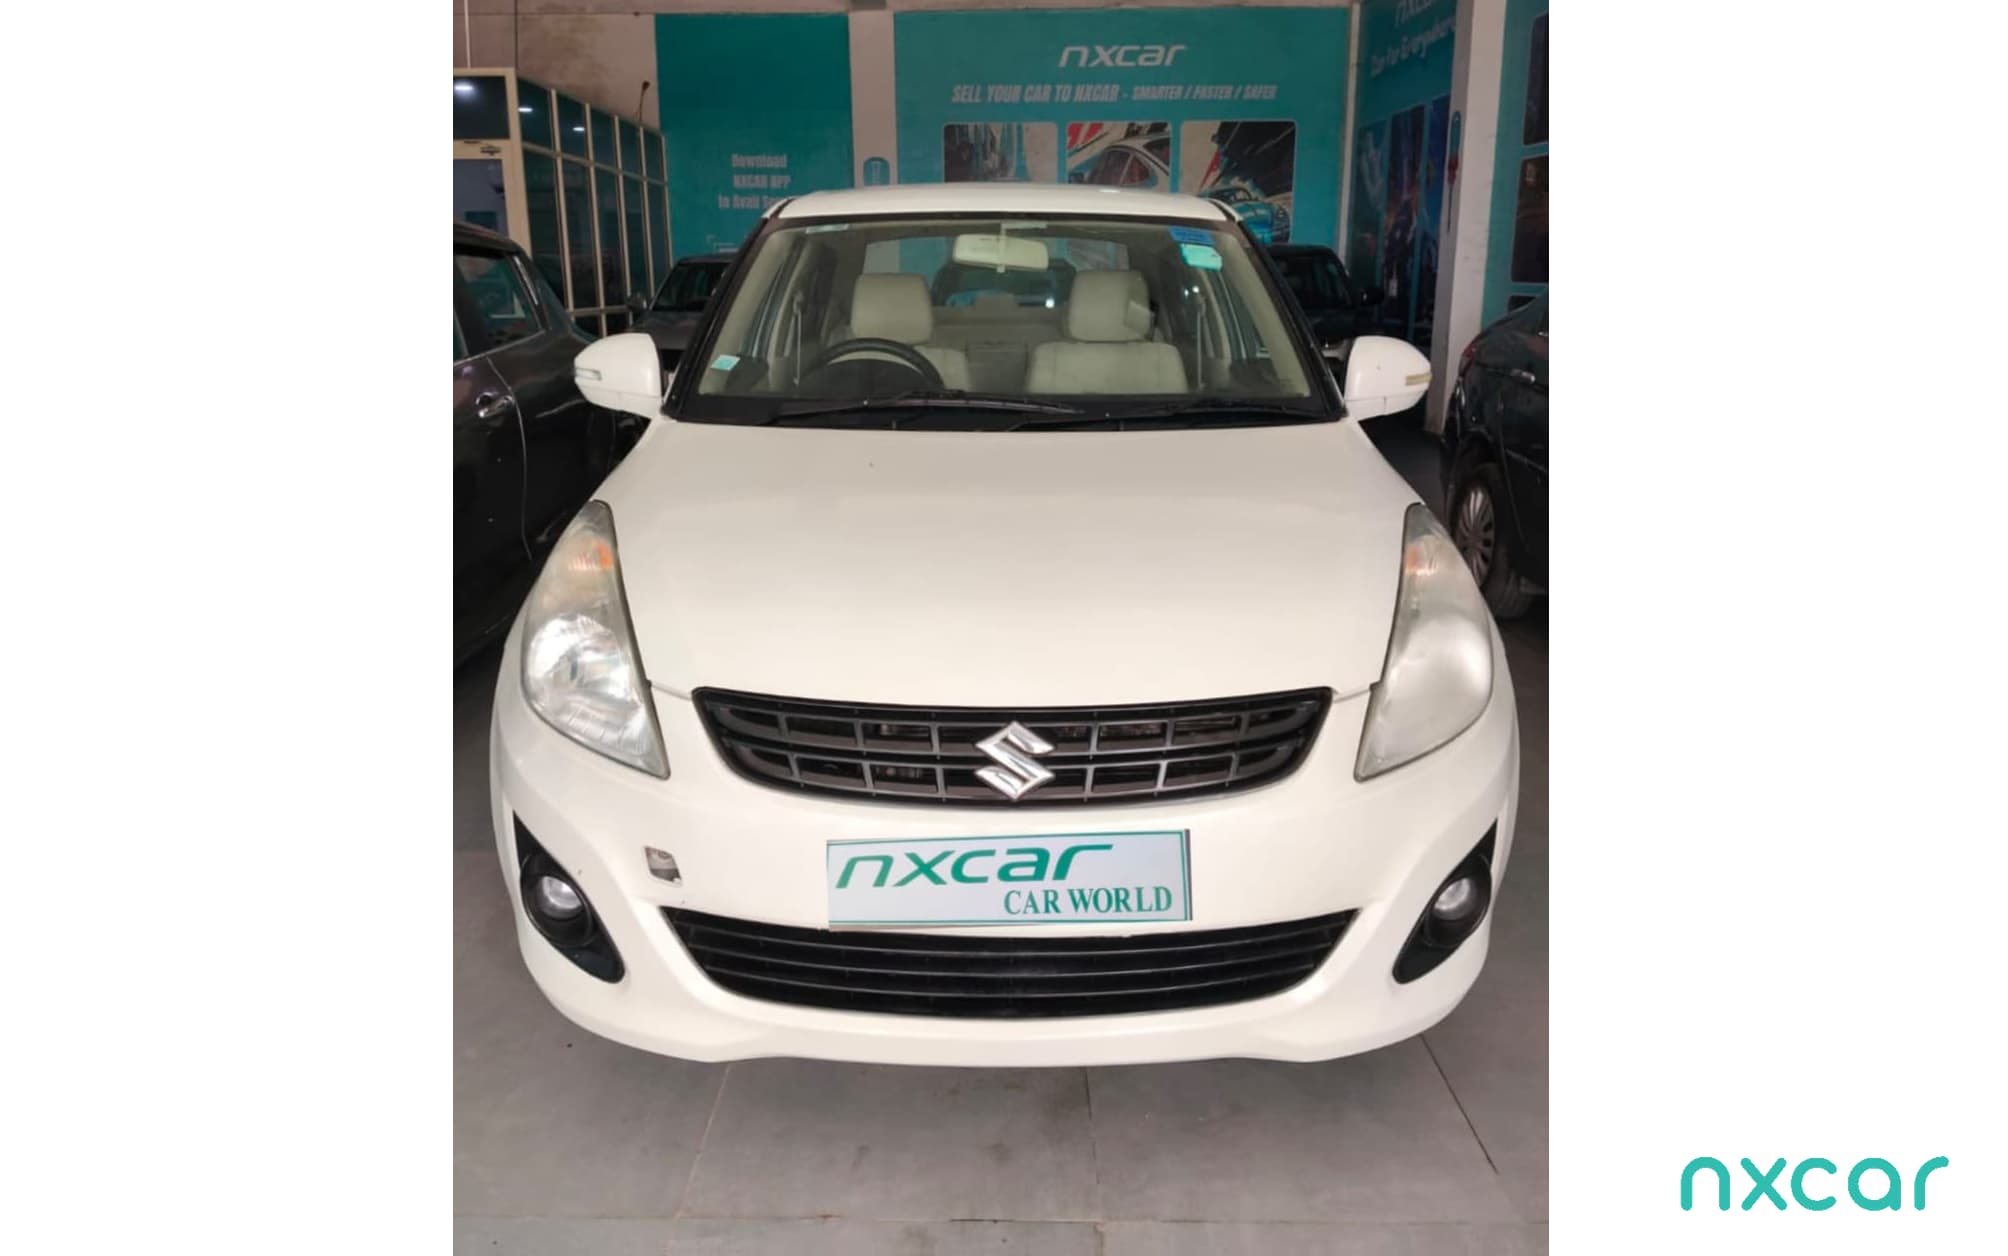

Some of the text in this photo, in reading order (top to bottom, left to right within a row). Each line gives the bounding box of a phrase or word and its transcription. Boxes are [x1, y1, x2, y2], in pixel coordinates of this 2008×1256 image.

[1058, 45, 1185, 67] nxcar
[952, 85, 981, 103] SELL
[987, 85, 1022, 103] YOUR
[1025, 85, 1052, 103] CAR
[1055, 85, 1072, 102] TO
[1074, 84, 1120, 102] NXCAR
[835, 844, 1114, 889] nxcar
[1004, 886, 1173, 916] CAR WORLD
